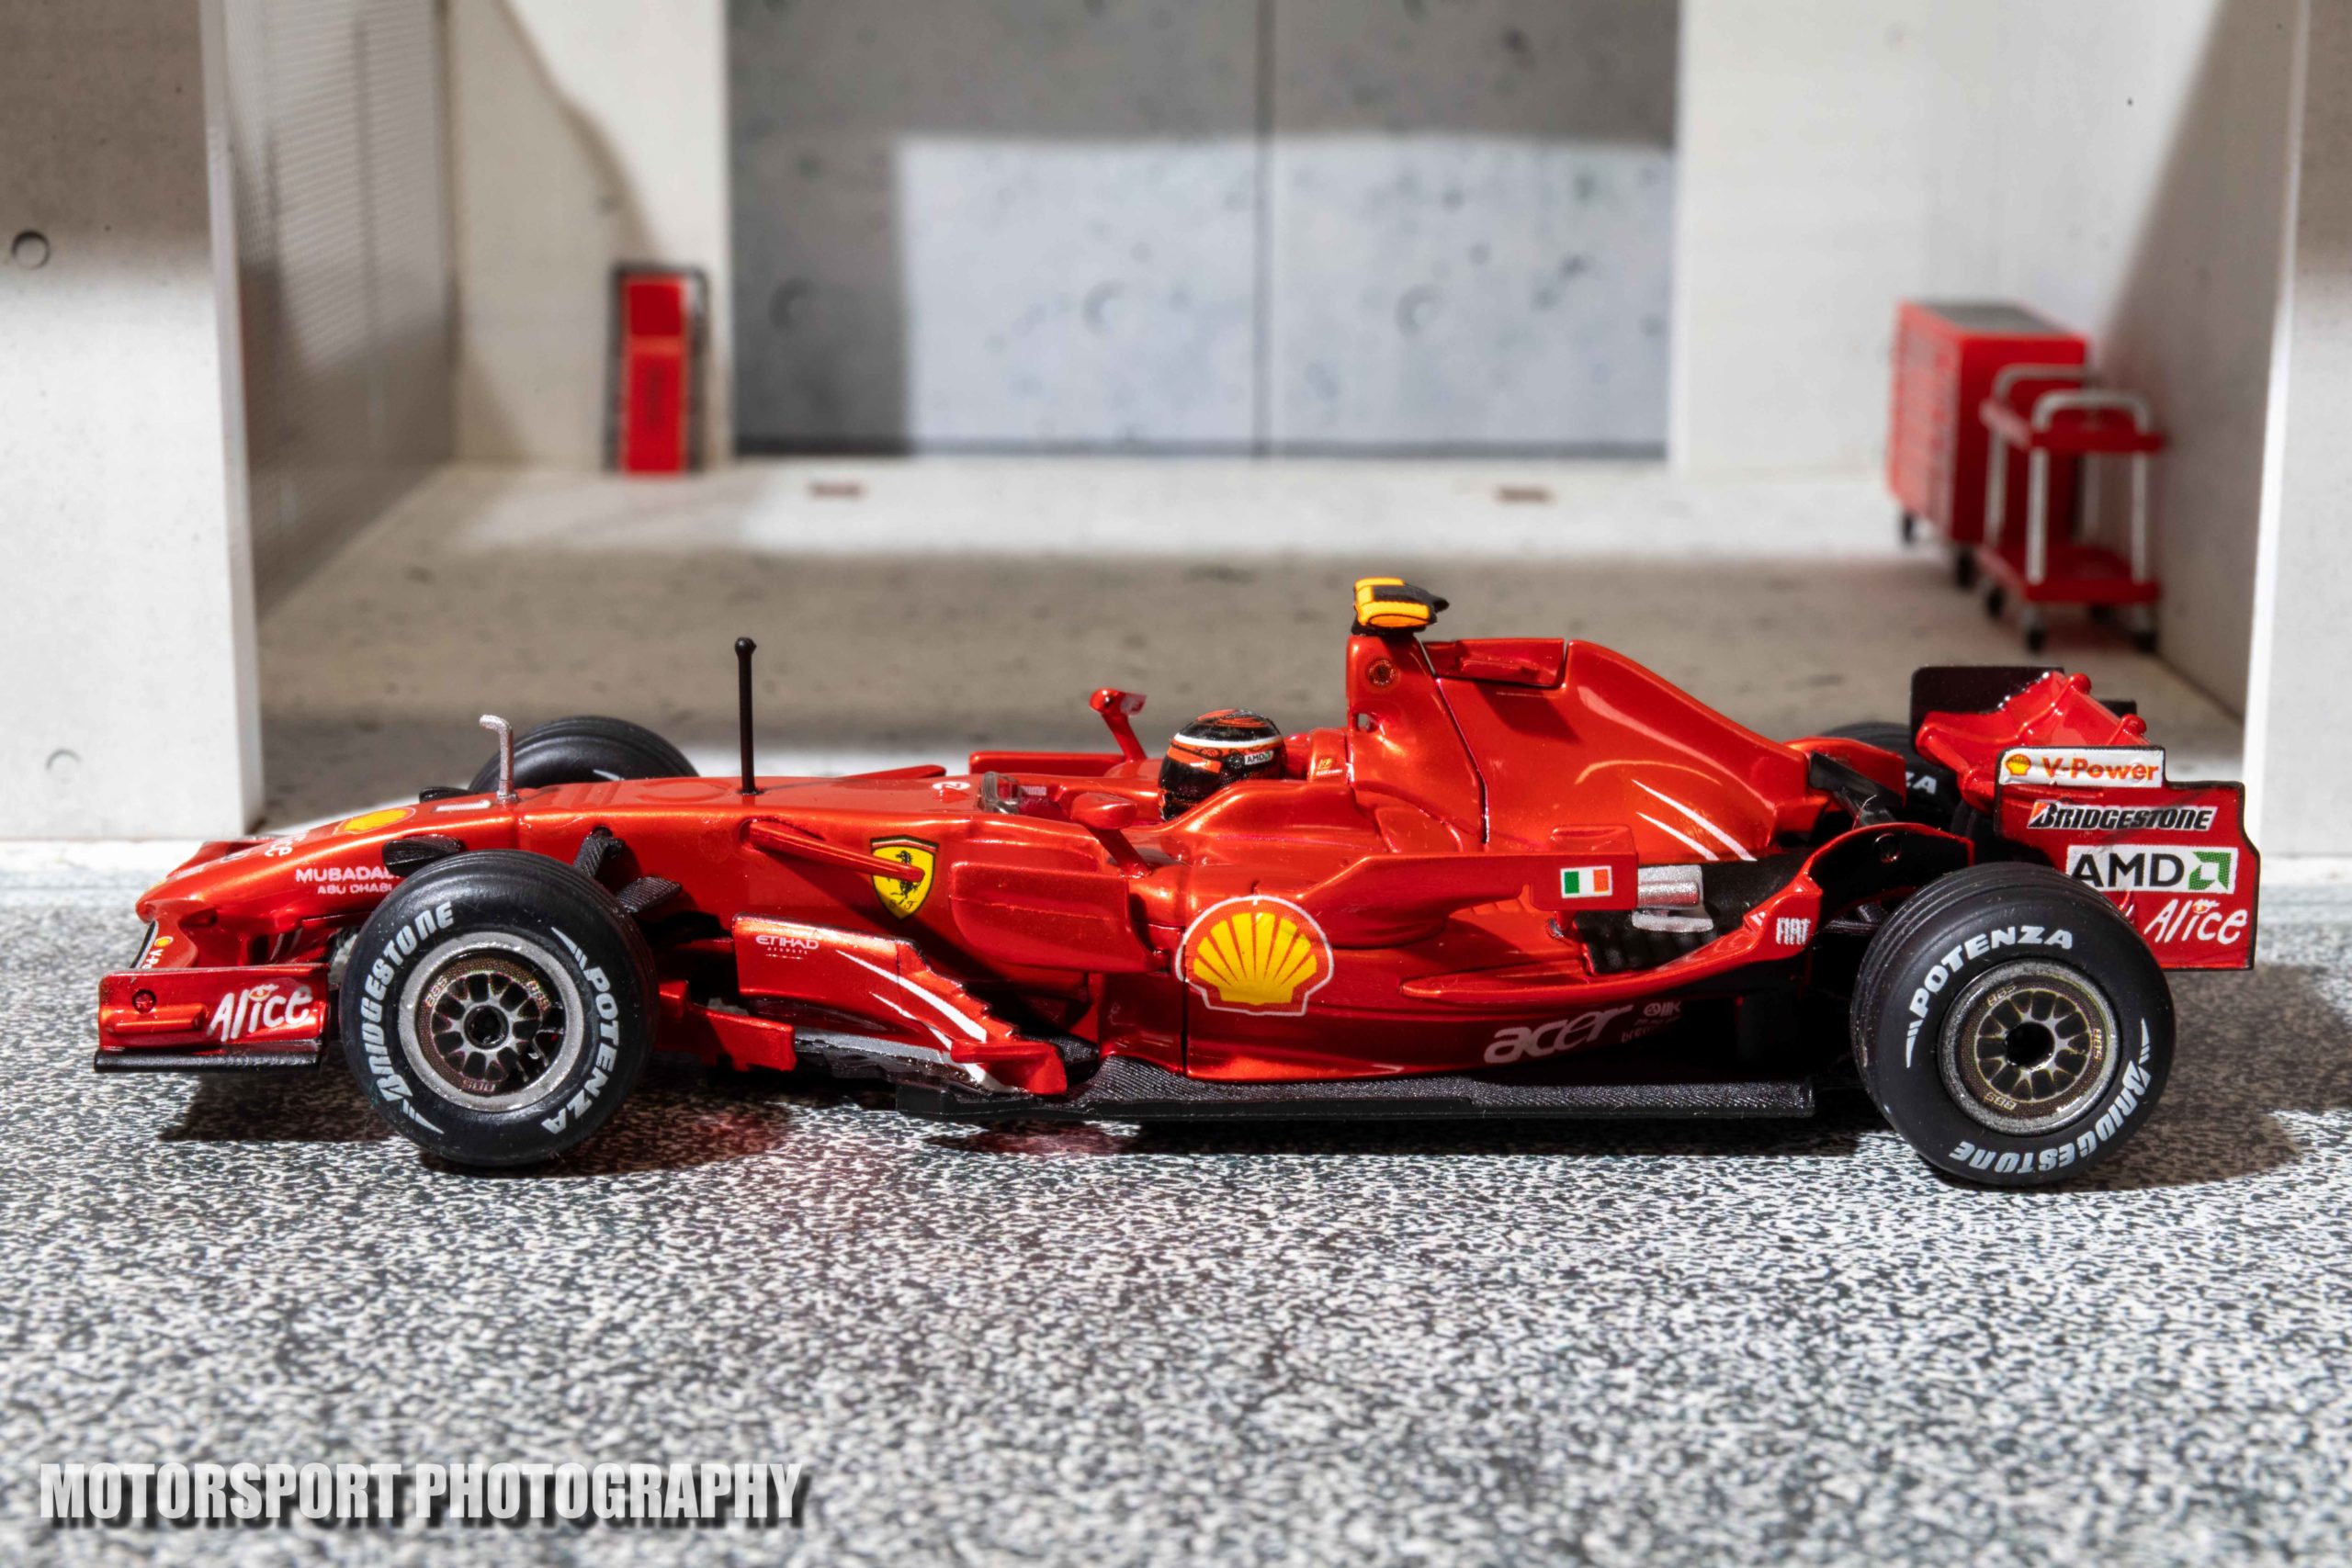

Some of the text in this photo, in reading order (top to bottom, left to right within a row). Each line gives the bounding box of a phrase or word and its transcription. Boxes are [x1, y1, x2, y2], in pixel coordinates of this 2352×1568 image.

[1246, 752, 1266, 763] AMD
[2041, 756, 2160, 781] V-Power
[2028, 802, 2215, 831] BRIDGESTONE
[294, 865, 403, 885] MUBADAL
[2067, 852, 2186, 888] AMD
[755, 933, 820, 951] ETIHAD
[1775, 917, 1812, 945] FIAT
[2143, 897, 2249, 945] Alice
[1907, 924, 2075, 1019] POTENZA
[204, 983, 315, 1043] Alice
[359, 900, 455, 1102] BRIDGESTONE
[540, 966, 621, 1135] POTENZA
[1483, 1003, 1635, 1065] acer
[1947, 1058, 2154, 1175] BRIDGESTONE
